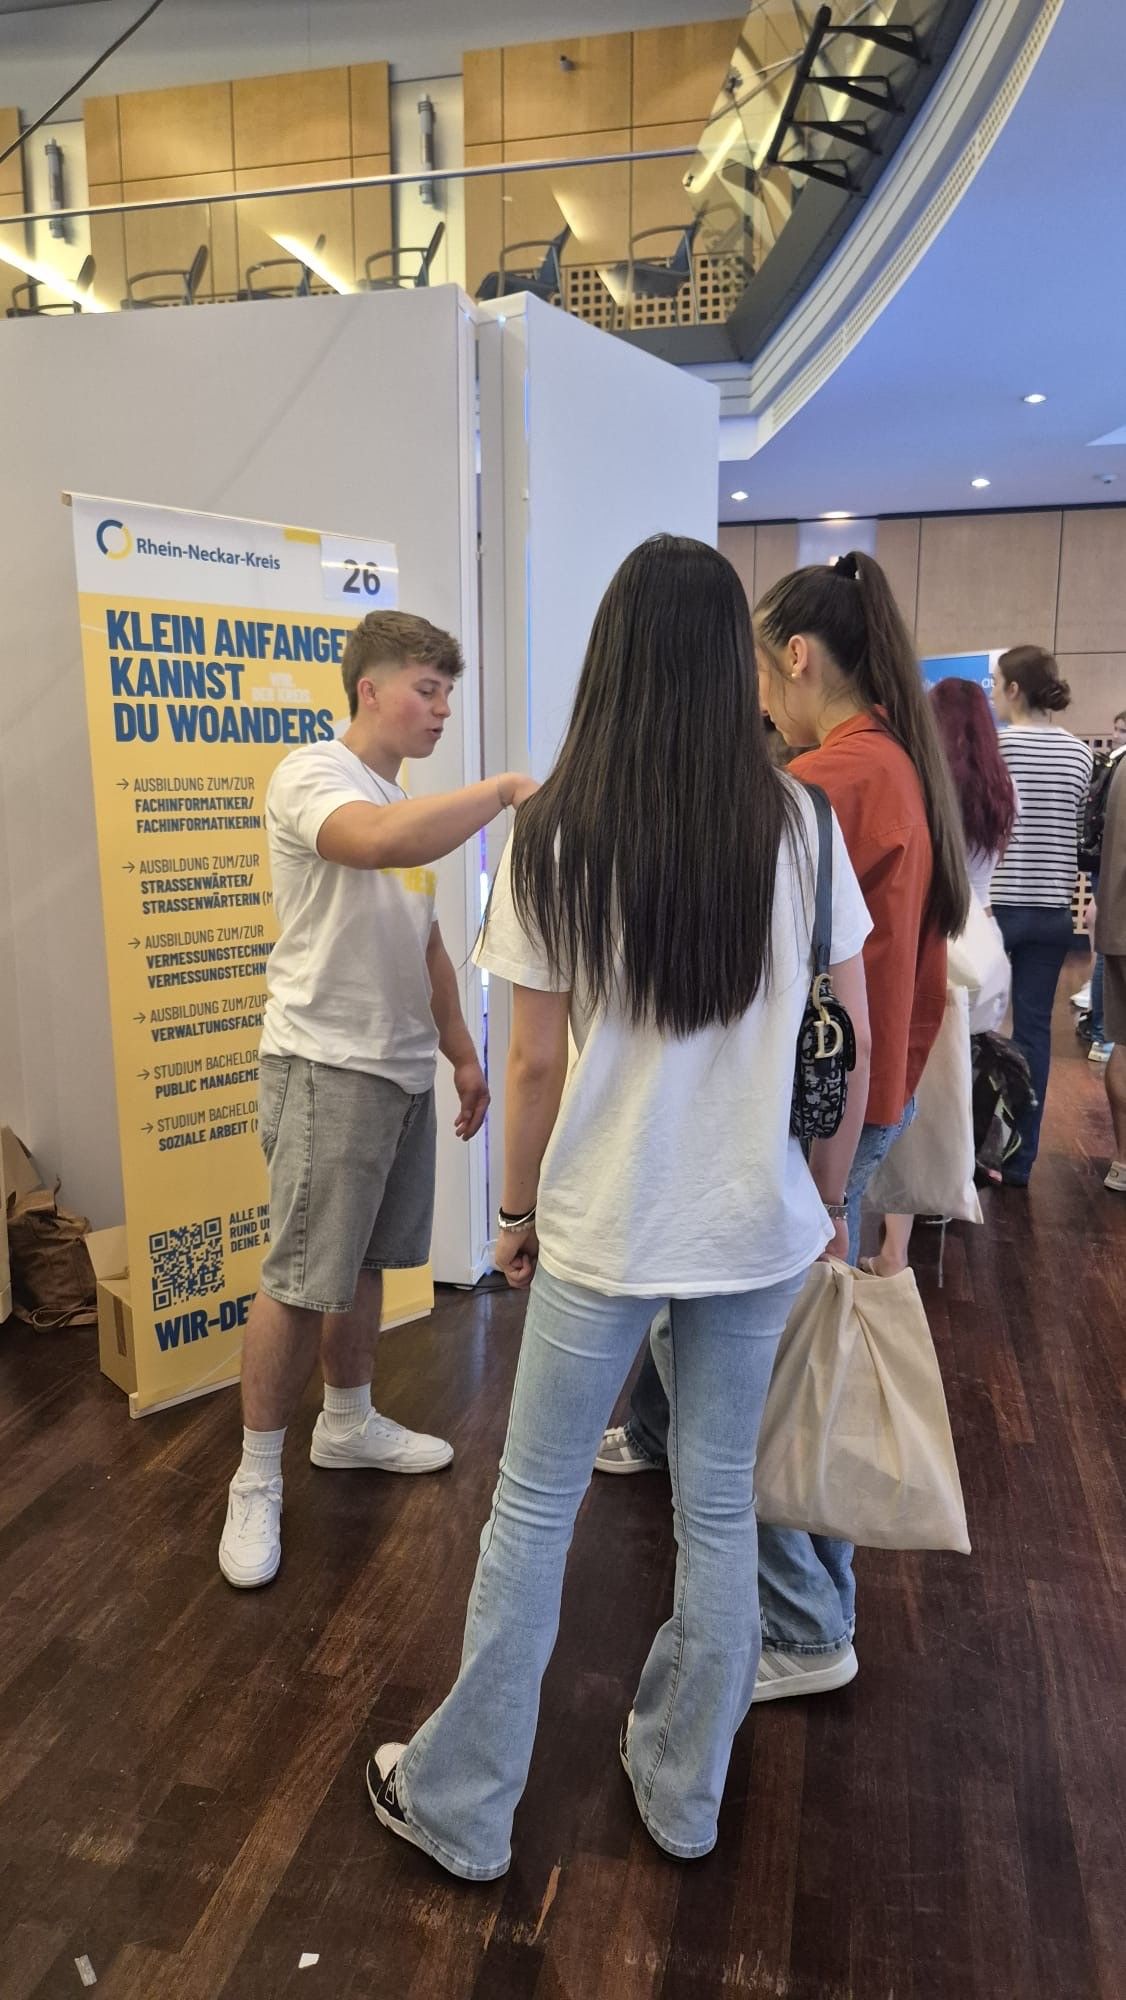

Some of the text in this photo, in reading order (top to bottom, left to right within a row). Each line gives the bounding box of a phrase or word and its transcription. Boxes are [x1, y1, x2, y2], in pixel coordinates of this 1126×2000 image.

[136, 538, 281, 571] Rhein-Neckar-Kreis
[342, 559, 381, 595] 26
[106, 609, 352, 664] KLEIN ANFANGE
[110, 656, 245, 700] KANNST
[114, 702, 334, 744] DU WOANDERS
[133, 776, 255, 793] AUSBILDUNG ZUM/ZUR
[135, 796, 254, 813] FACHINFORMATIKER/
[136, 815, 261, 834] FACHINFORMATIKERIN
[139, 854, 260, 875] AUSBILDUNG ZUM/ZUR
[141, 873, 253, 895] STRASSENWÄRTER/
[142, 891, 261, 915] STRASSENWÄRTERIN
[144, 924, 264, 950] AUSBILDUNG ZUM/ZUR
[146, 942, 276, 969] VERMESSUNGSTECHNIK
[147, 961, 267, 989] VERMESSUNGSTECHN
[150, 1002, 220, 1024] AUSBILDUNG
[151, 1011, 266, 1043] VERWALTUNGSFACH
[154, 1060, 203, 1080] STUDIUM
[155, 1068, 259, 1100] PUBLIC MANAGEME
[157, 1112, 206, 1134] STUDIUM
[159, 1130, 207, 1152] SOZIALE
[209, 1120, 248, 1141] ARBEIT
[229, 1207, 254, 1225] ALLE
[230, 1221, 257, 1239] RUND
[231, 1234, 260, 1253] DEINE
[155, 1292, 257, 1352] WIR-DE
